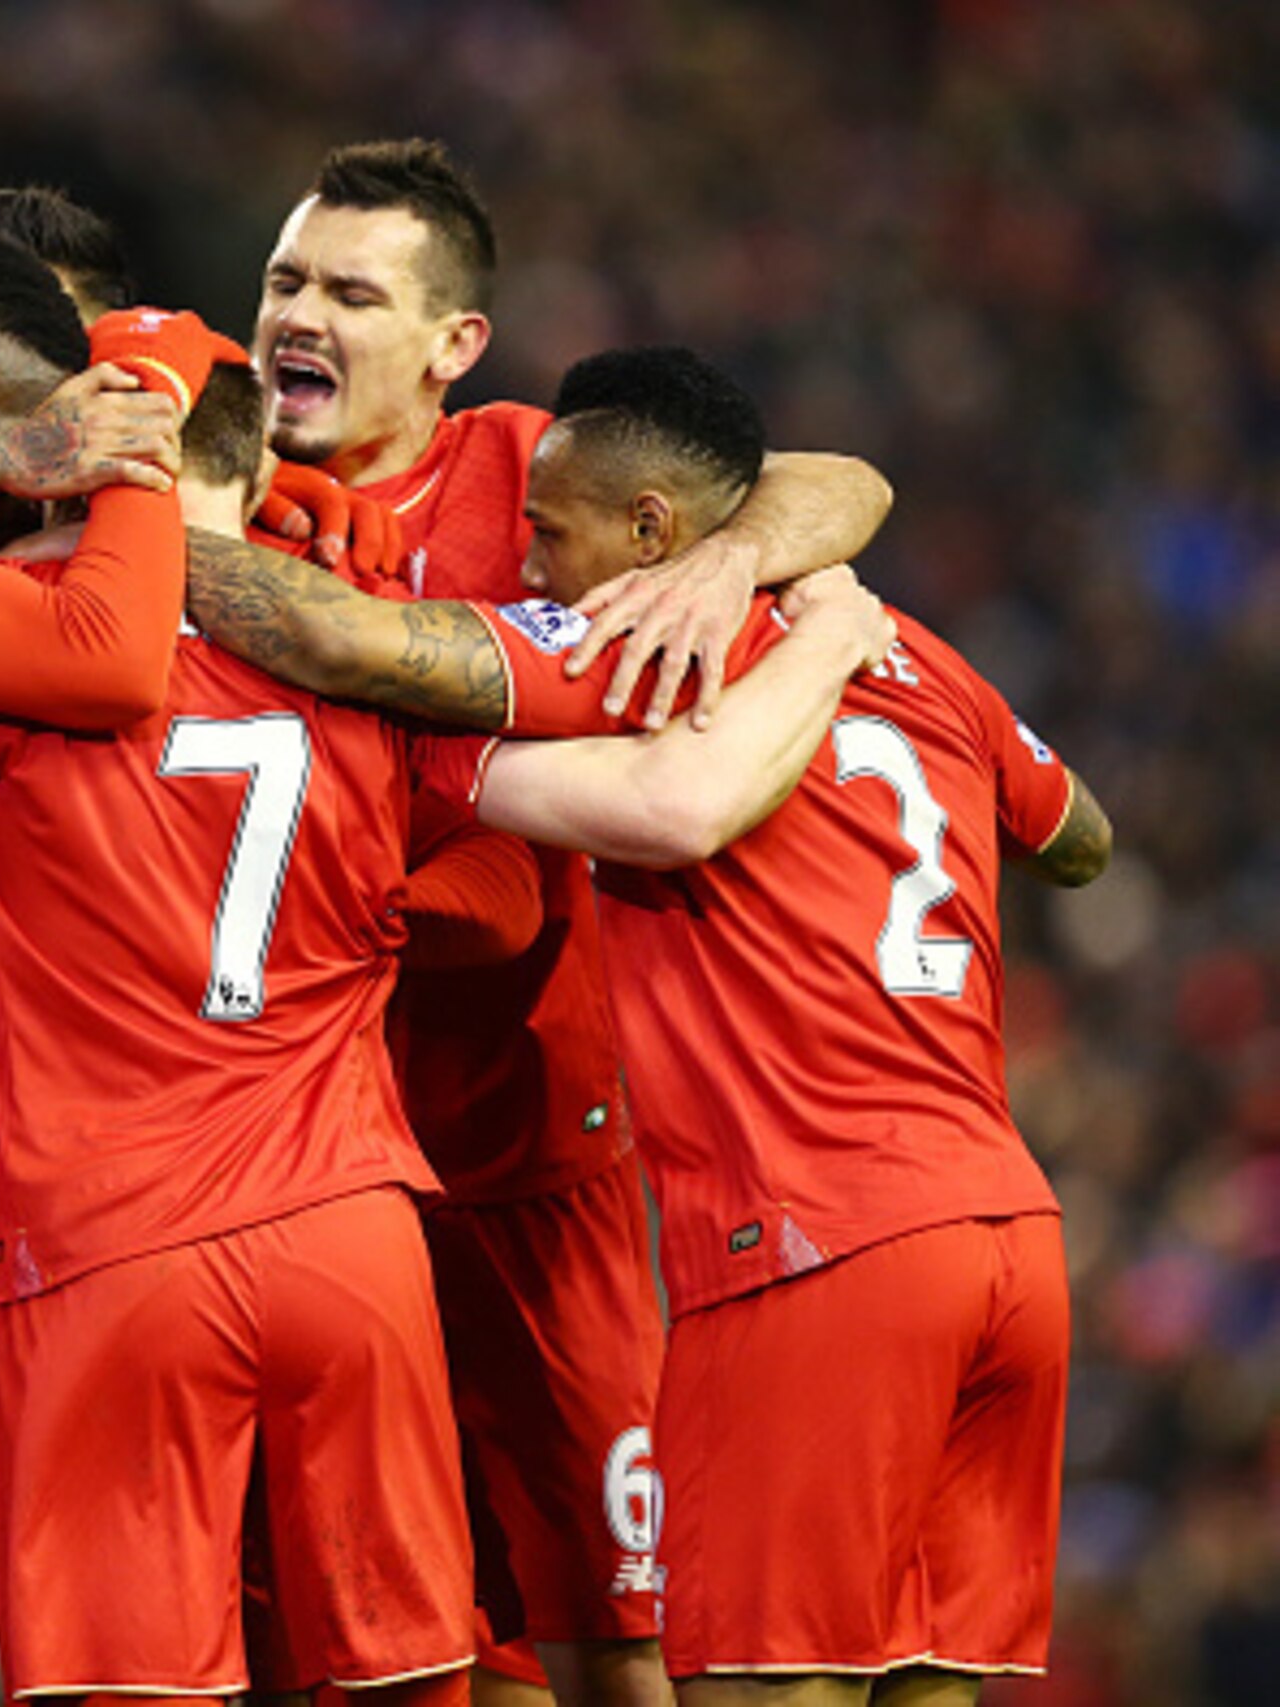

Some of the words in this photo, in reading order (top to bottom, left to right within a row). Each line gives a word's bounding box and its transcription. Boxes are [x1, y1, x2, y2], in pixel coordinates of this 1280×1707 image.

[157, 711, 312, 1021] 7
[831, 715, 974, 998] 2
[603, 1426, 665, 1553] 6
